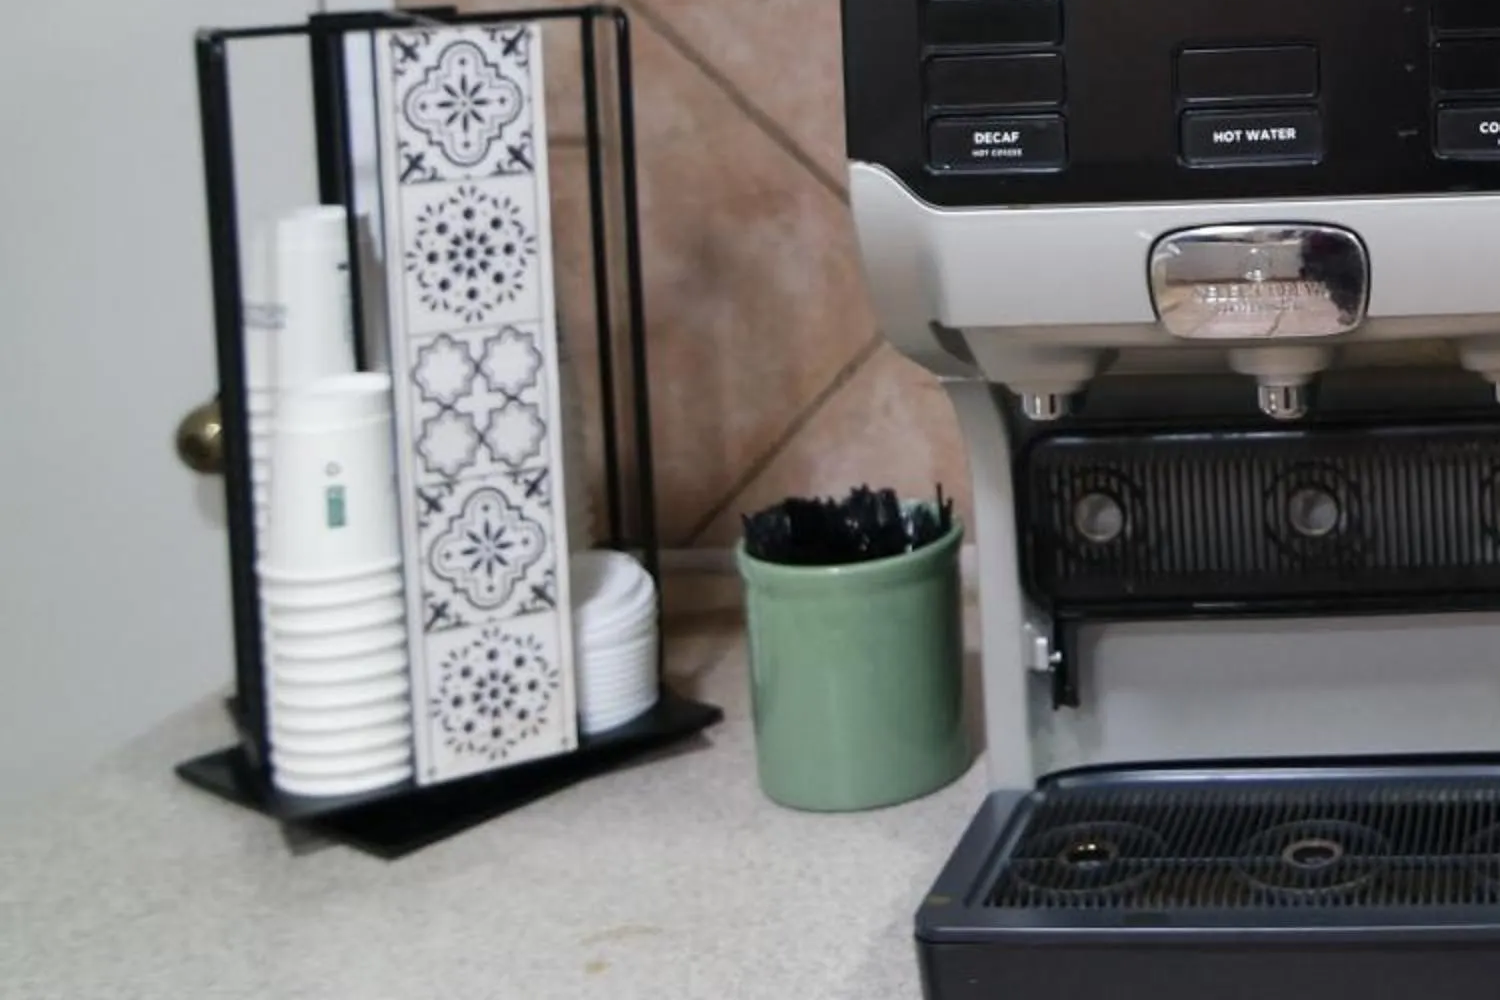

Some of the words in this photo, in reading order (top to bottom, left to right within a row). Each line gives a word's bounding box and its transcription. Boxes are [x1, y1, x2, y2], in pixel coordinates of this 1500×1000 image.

[973, 131, 1021, 145] DECAF
[1213, 129, 1243, 143] HOT
[1245, 127, 1297, 141] WATER
